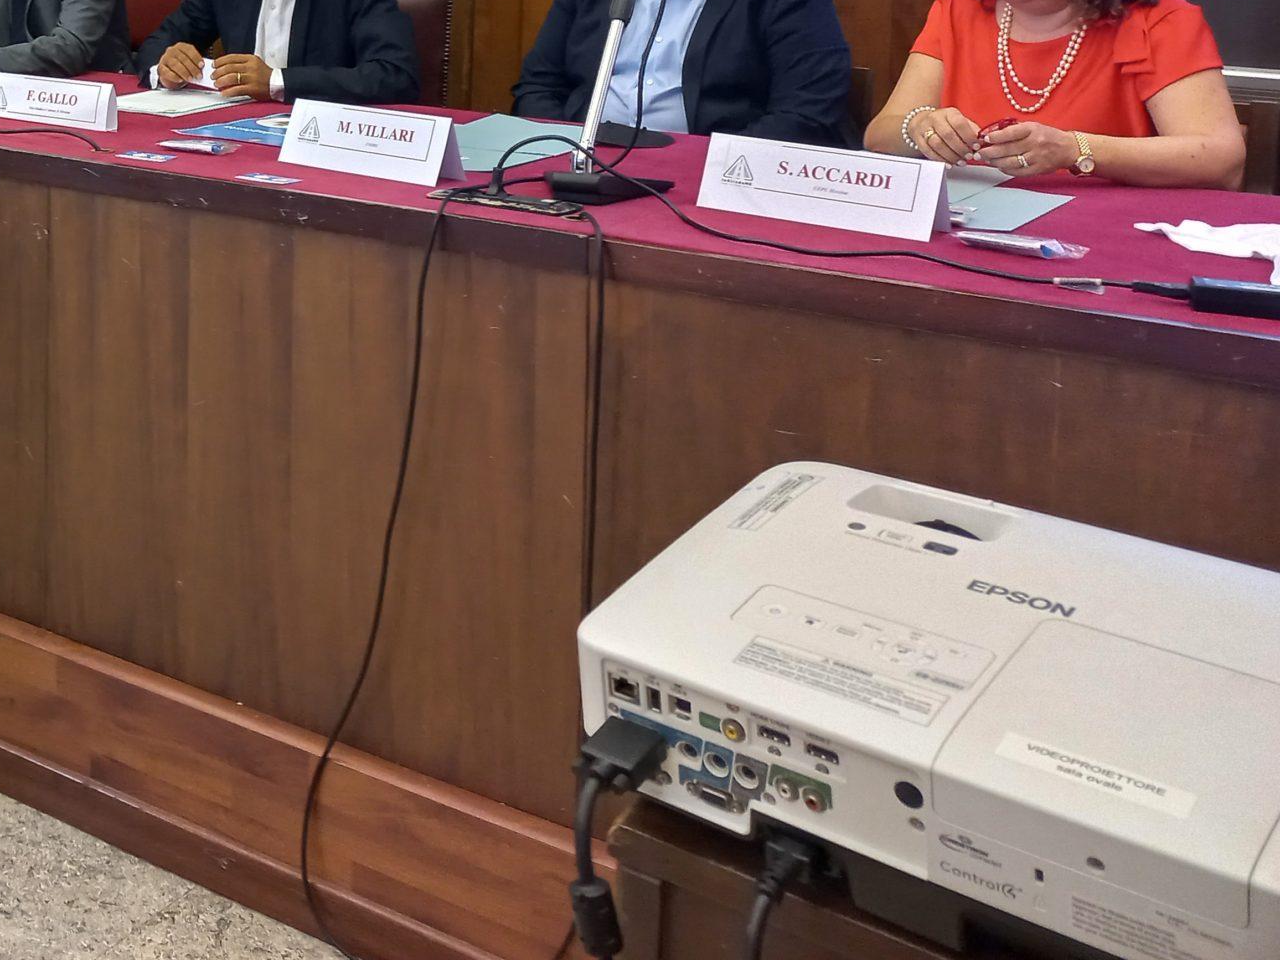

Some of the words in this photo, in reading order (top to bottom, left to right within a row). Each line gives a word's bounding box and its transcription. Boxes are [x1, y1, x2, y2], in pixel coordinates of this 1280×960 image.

[26, 89, 36, 102] F.
[37, 91, 78, 106] GALLO
[337, 120, 354, 134] M.
[357, 123, 416, 143] VILLARI
[776, 160, 793, 176] S.
[796, 163, 892, 190] ACCARDI
[966, 580, 1076, 617] EPSON
[1027, 743, 1167, 797] VIDEOPROIETTORE
[1056, 764, 1083, 780] sala
[1086, 775, 1123, 792] ovale
